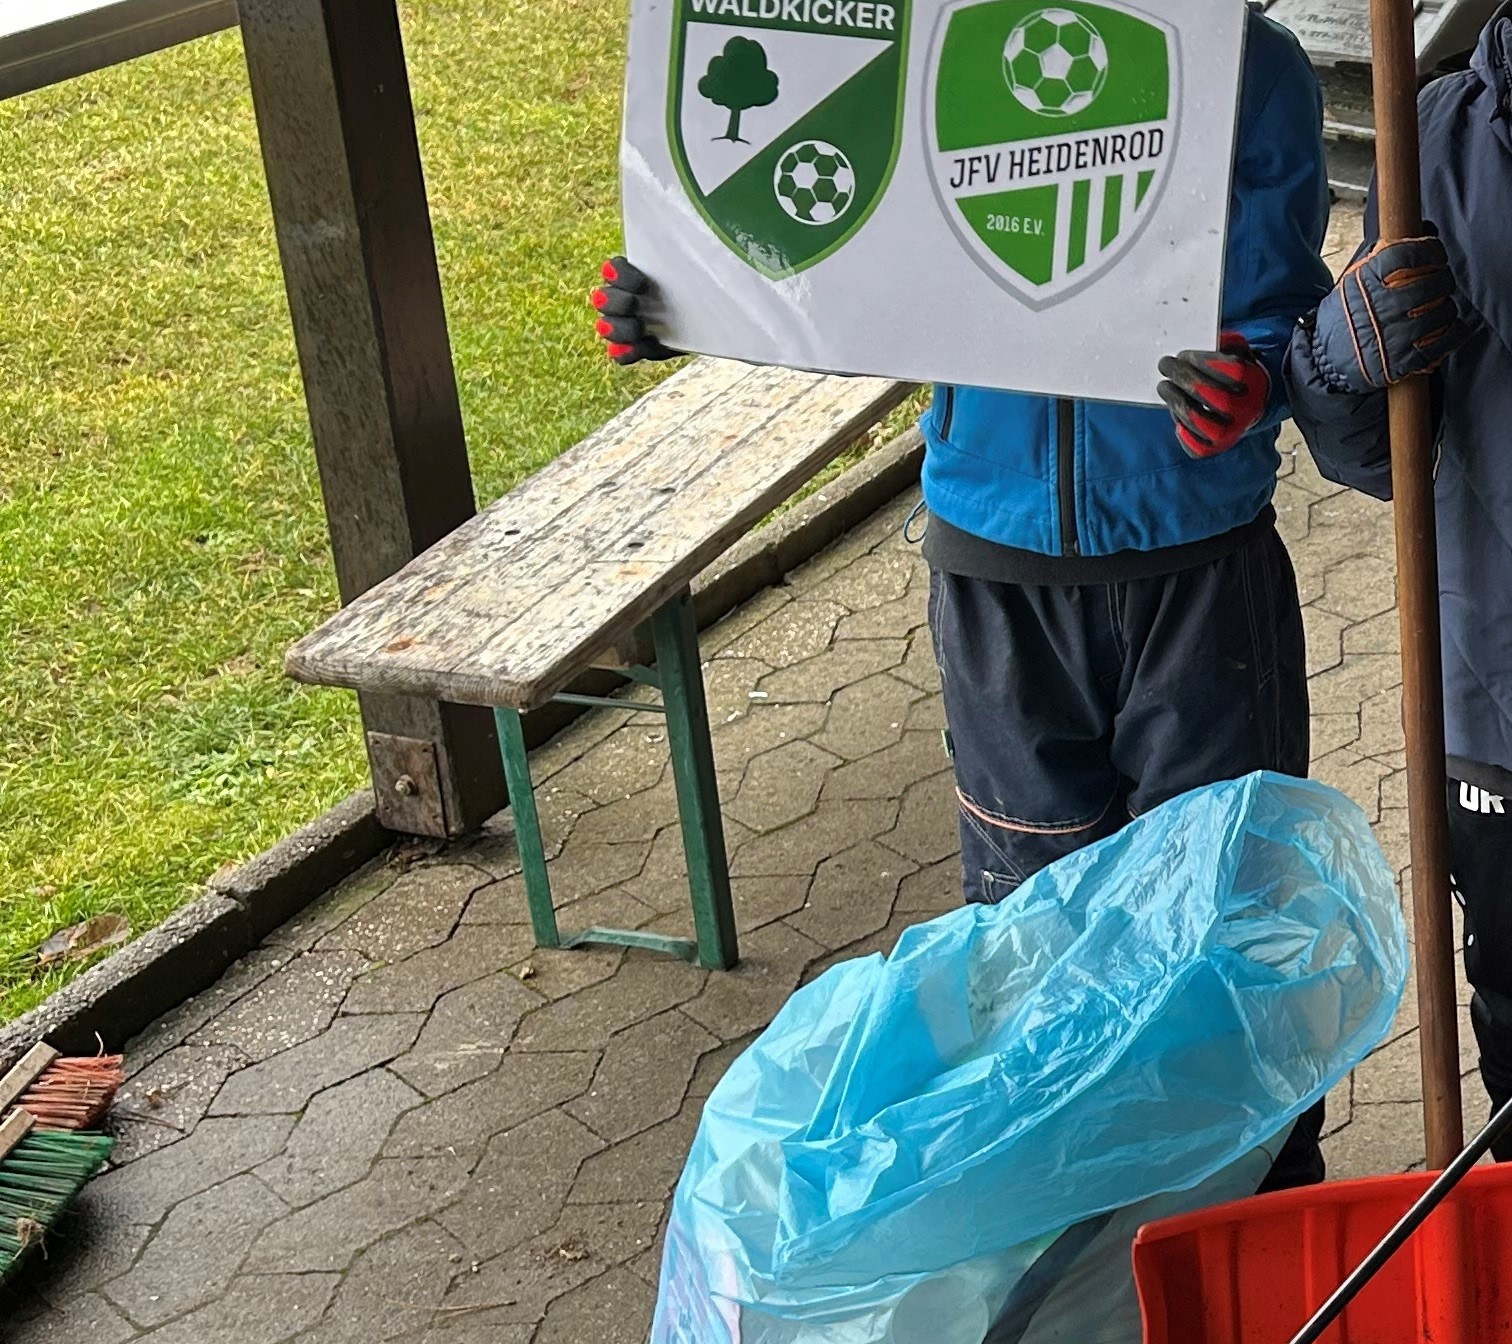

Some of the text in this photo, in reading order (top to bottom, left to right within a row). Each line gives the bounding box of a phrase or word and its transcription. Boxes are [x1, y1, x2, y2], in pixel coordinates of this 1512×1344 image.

[950, 128, 1164, 189] JFV HEIDENROD
[986, 213, 1020, 233] 2016
